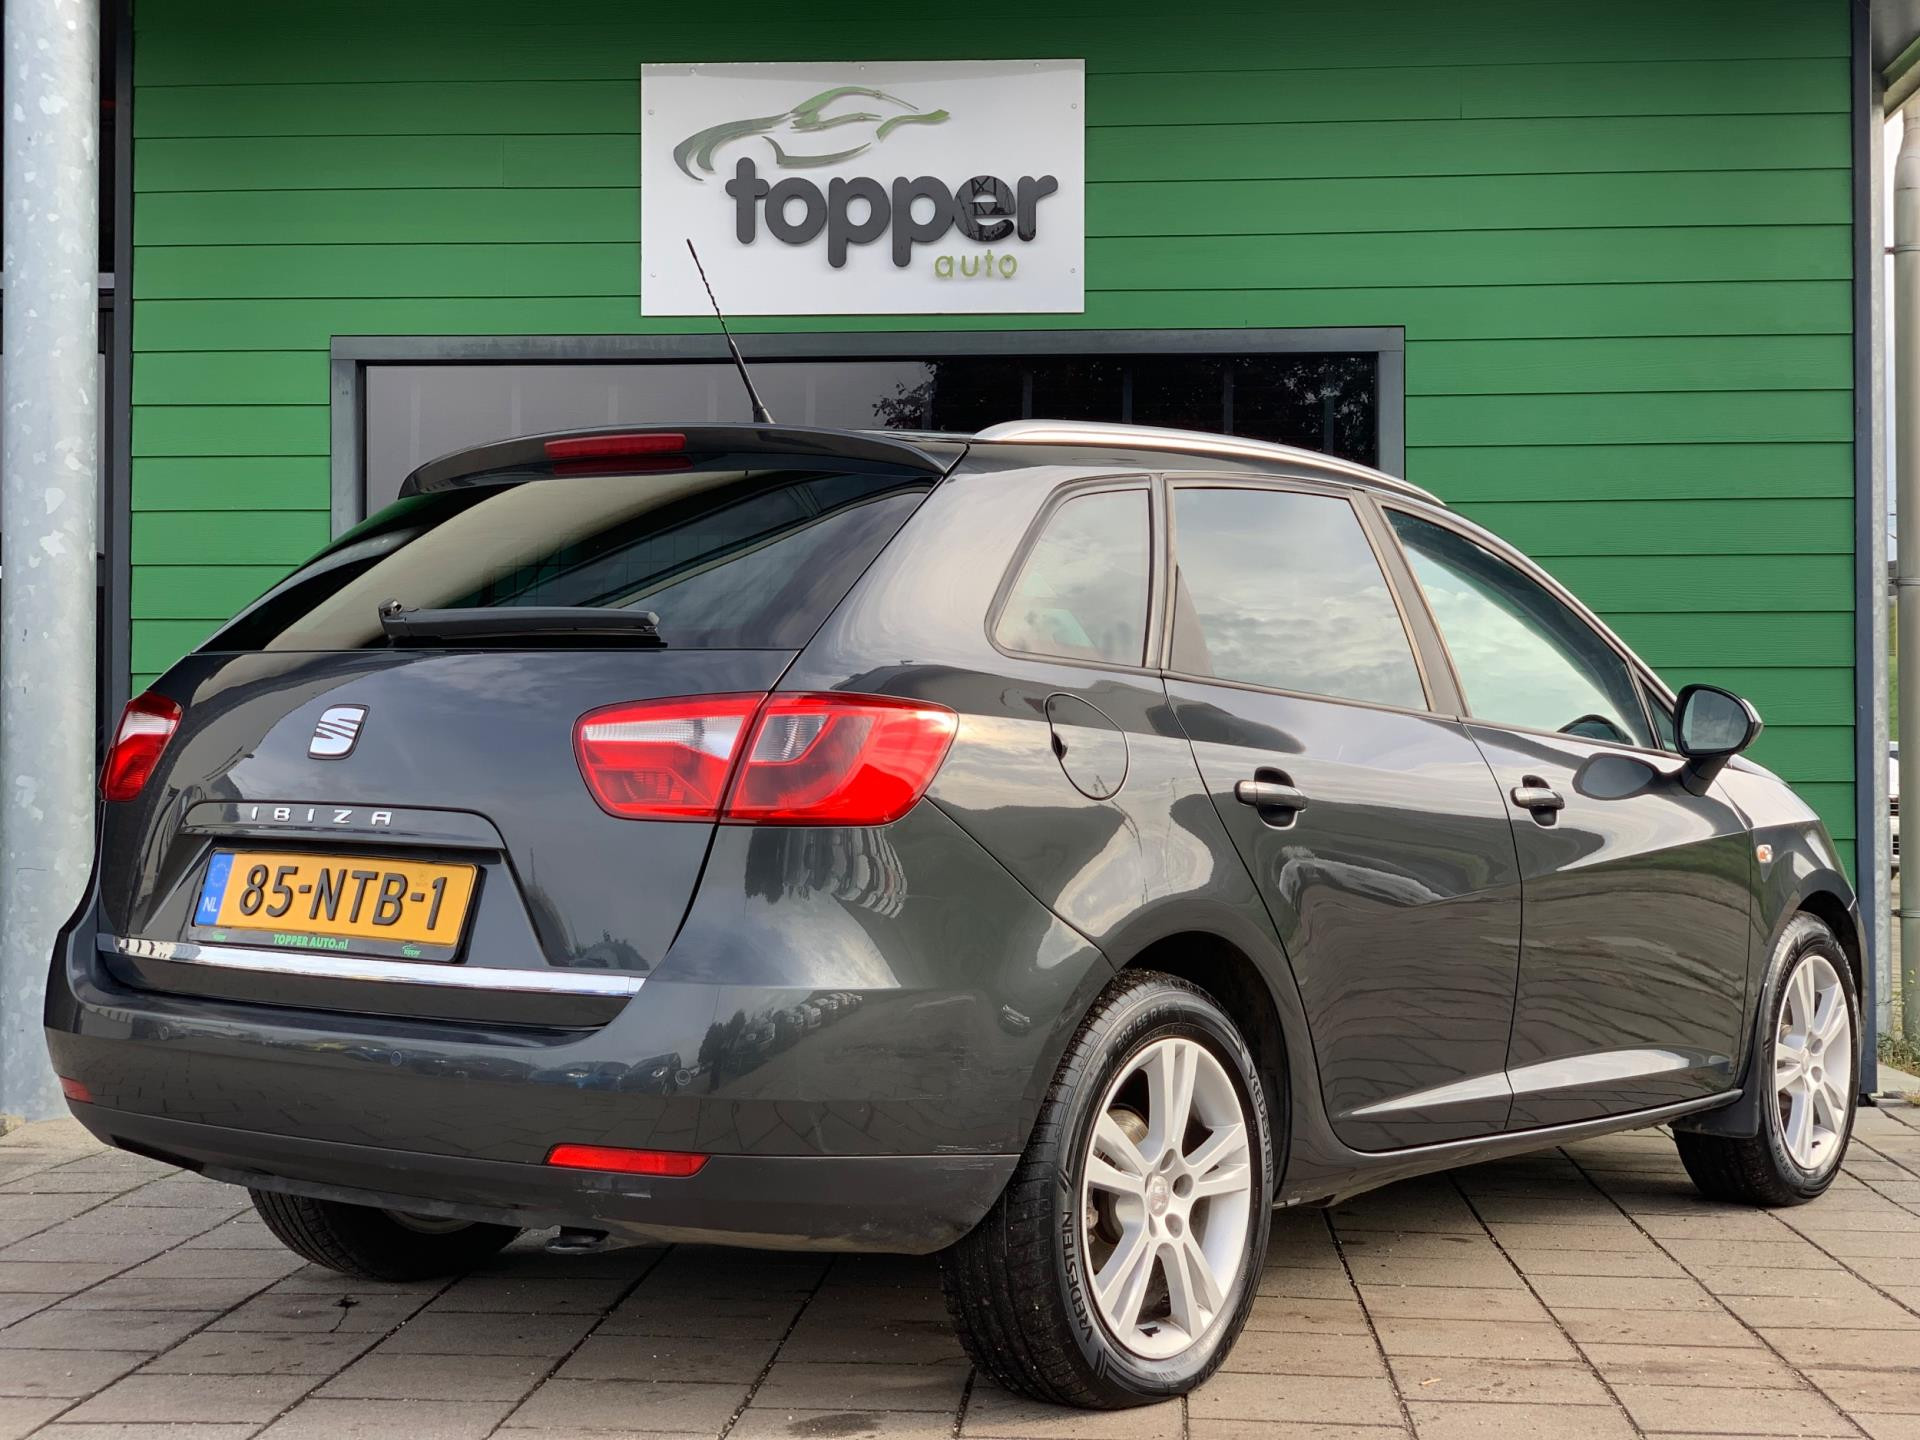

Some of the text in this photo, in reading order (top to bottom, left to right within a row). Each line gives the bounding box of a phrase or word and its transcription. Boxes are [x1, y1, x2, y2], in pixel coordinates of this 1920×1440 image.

[725, 157, 1059, 269] topper
[934, 249, 1018, 279] auto
[251, 806, 393, 826] IBIZA
[202, 896, 218, 914] NL
[239, 864, 448, 930] 85-NTB-1
[273, 933, 349, 949] TOPPER AUTO.nl
[1115, 1012, 1148, 1049] 205/55
[1248, 1062, 1272, 1185] VREDESTEIN
[1062, 1211, 1094, 1343] VREDESTEIN
